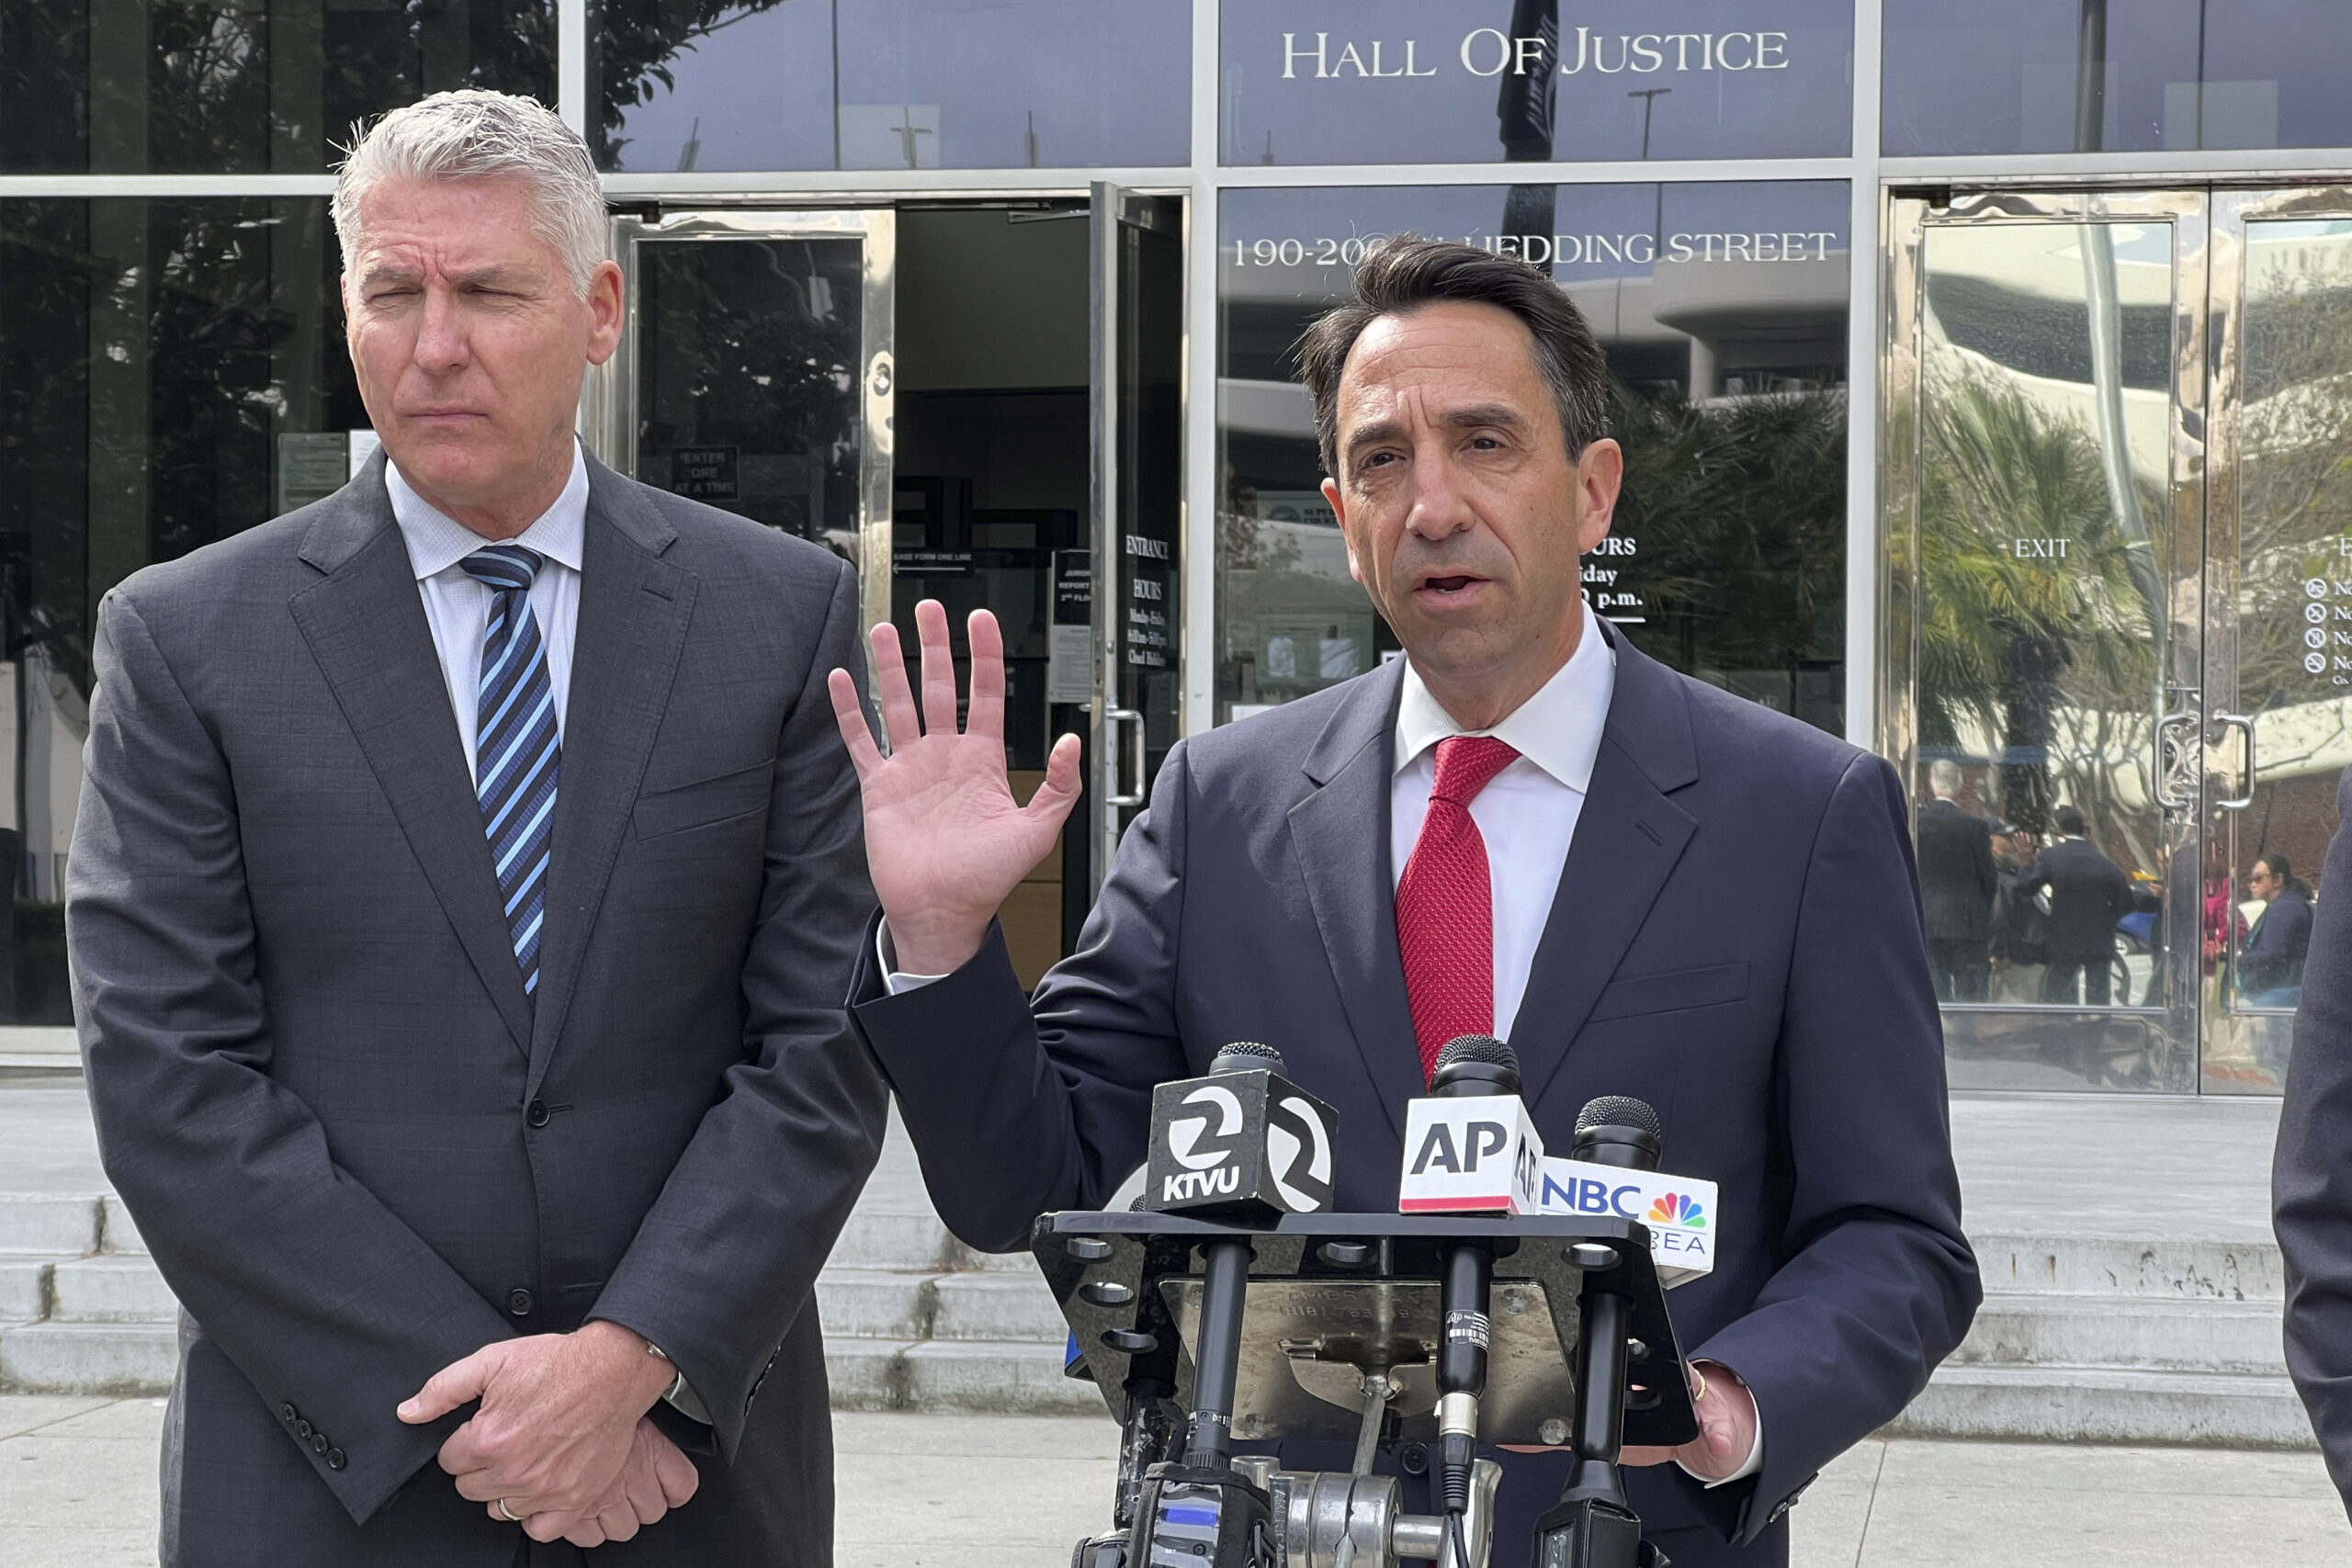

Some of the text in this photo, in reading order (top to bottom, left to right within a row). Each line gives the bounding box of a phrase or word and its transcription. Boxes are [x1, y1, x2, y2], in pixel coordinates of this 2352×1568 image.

[1282, 27, 1790, 78] HALL OF JUSTICE
[1235, 238, 1385, 266] 190-20
[1668, 233, 1837, 263] STREET
[1125, 535, 1169, 559] ENTRANCE
[1579, 537, 1636, 555] URS
[2016, 538, 2071, 558] EXIT
[1134, 579, 1161, 600] HOURS
[1598, 593, 1643, 609] p.m.
[1410, 1122, 1508, 1175] AP
[1163, 1166, 1240, 1201] KTVU
[1542, 1172, 1641, 1220] NBC
